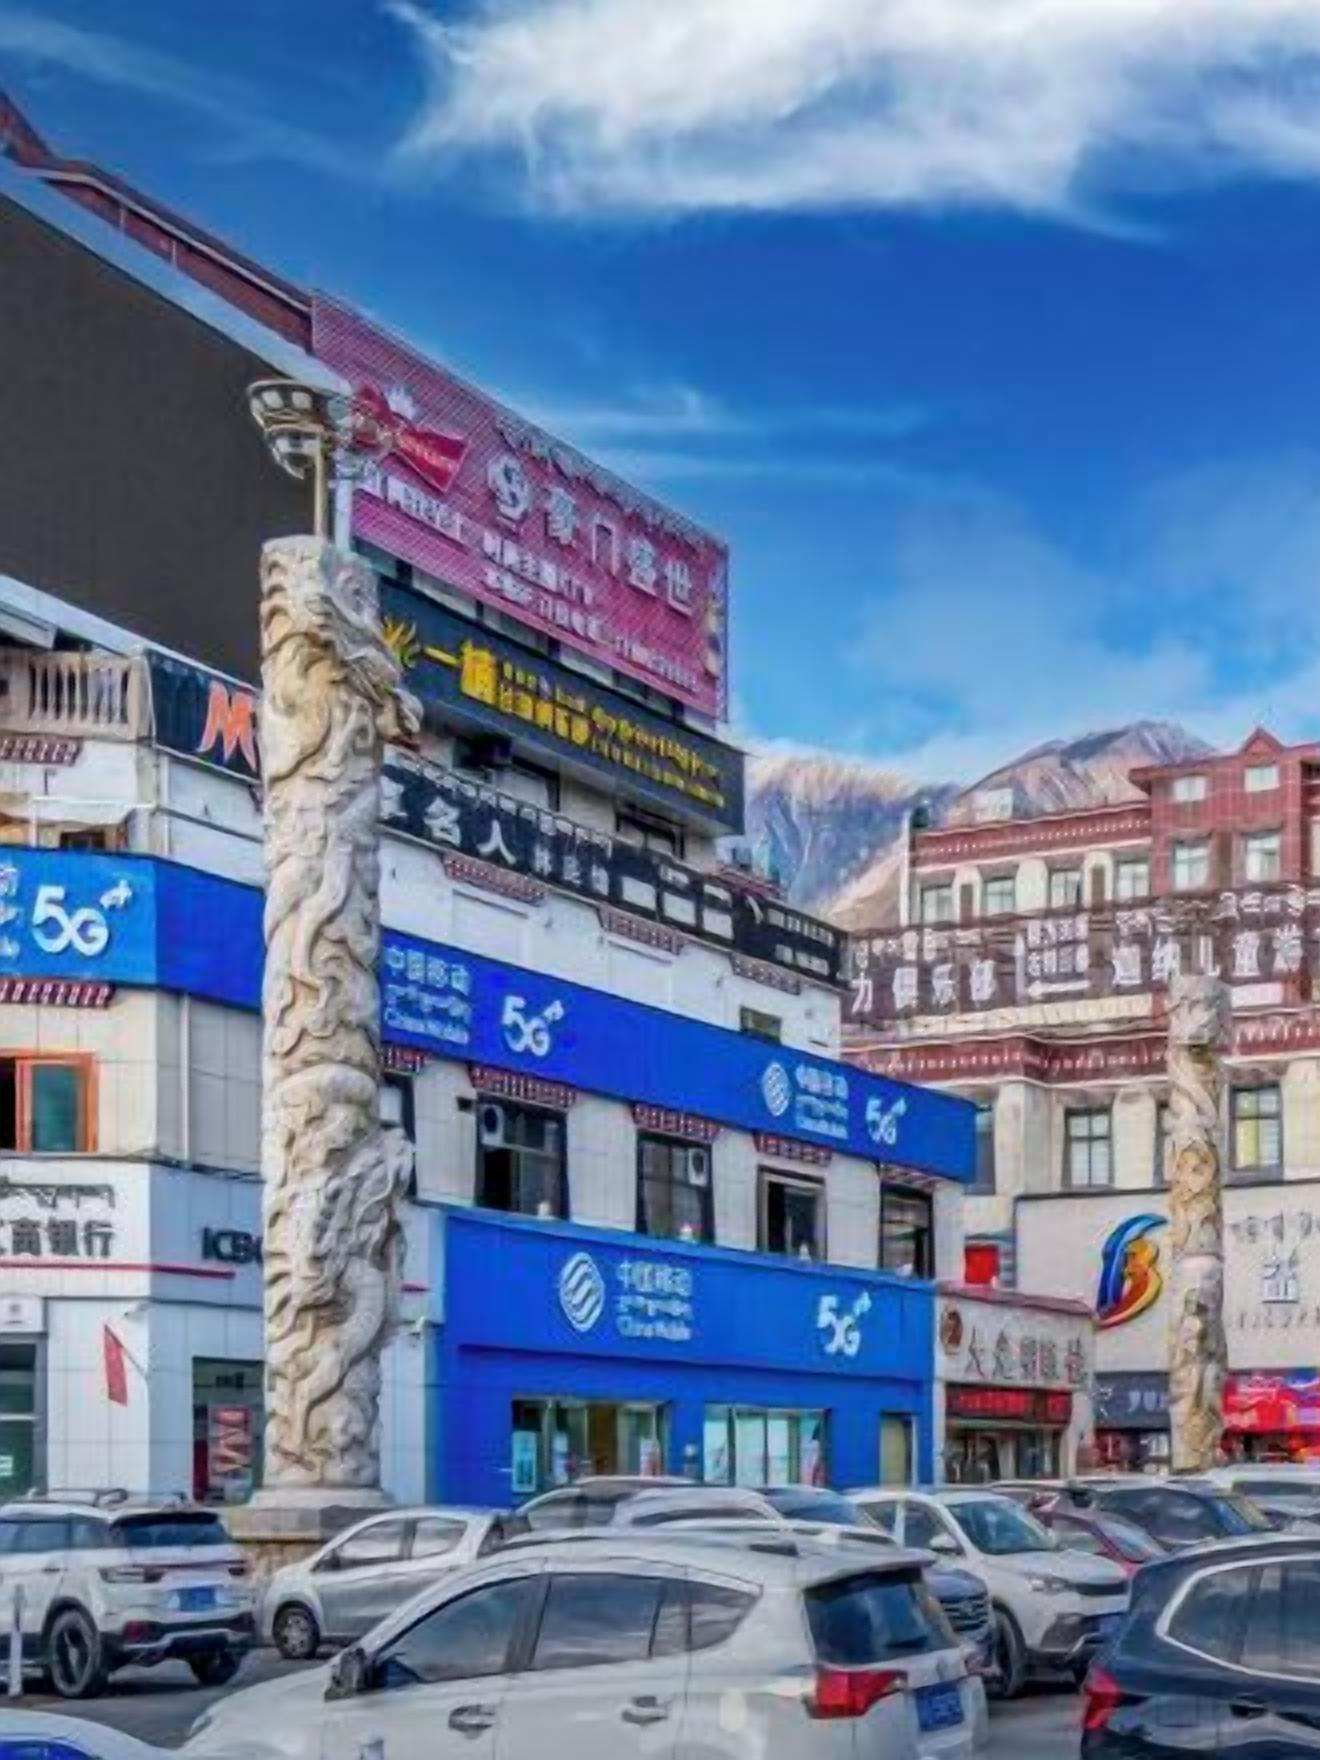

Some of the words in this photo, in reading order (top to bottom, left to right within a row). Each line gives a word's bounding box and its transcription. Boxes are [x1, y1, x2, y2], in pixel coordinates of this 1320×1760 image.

[32, 886, 109, 957] 5G
[502, 995, 551, 1057] 5G
[817, 1294, 861, 1356] 5G
